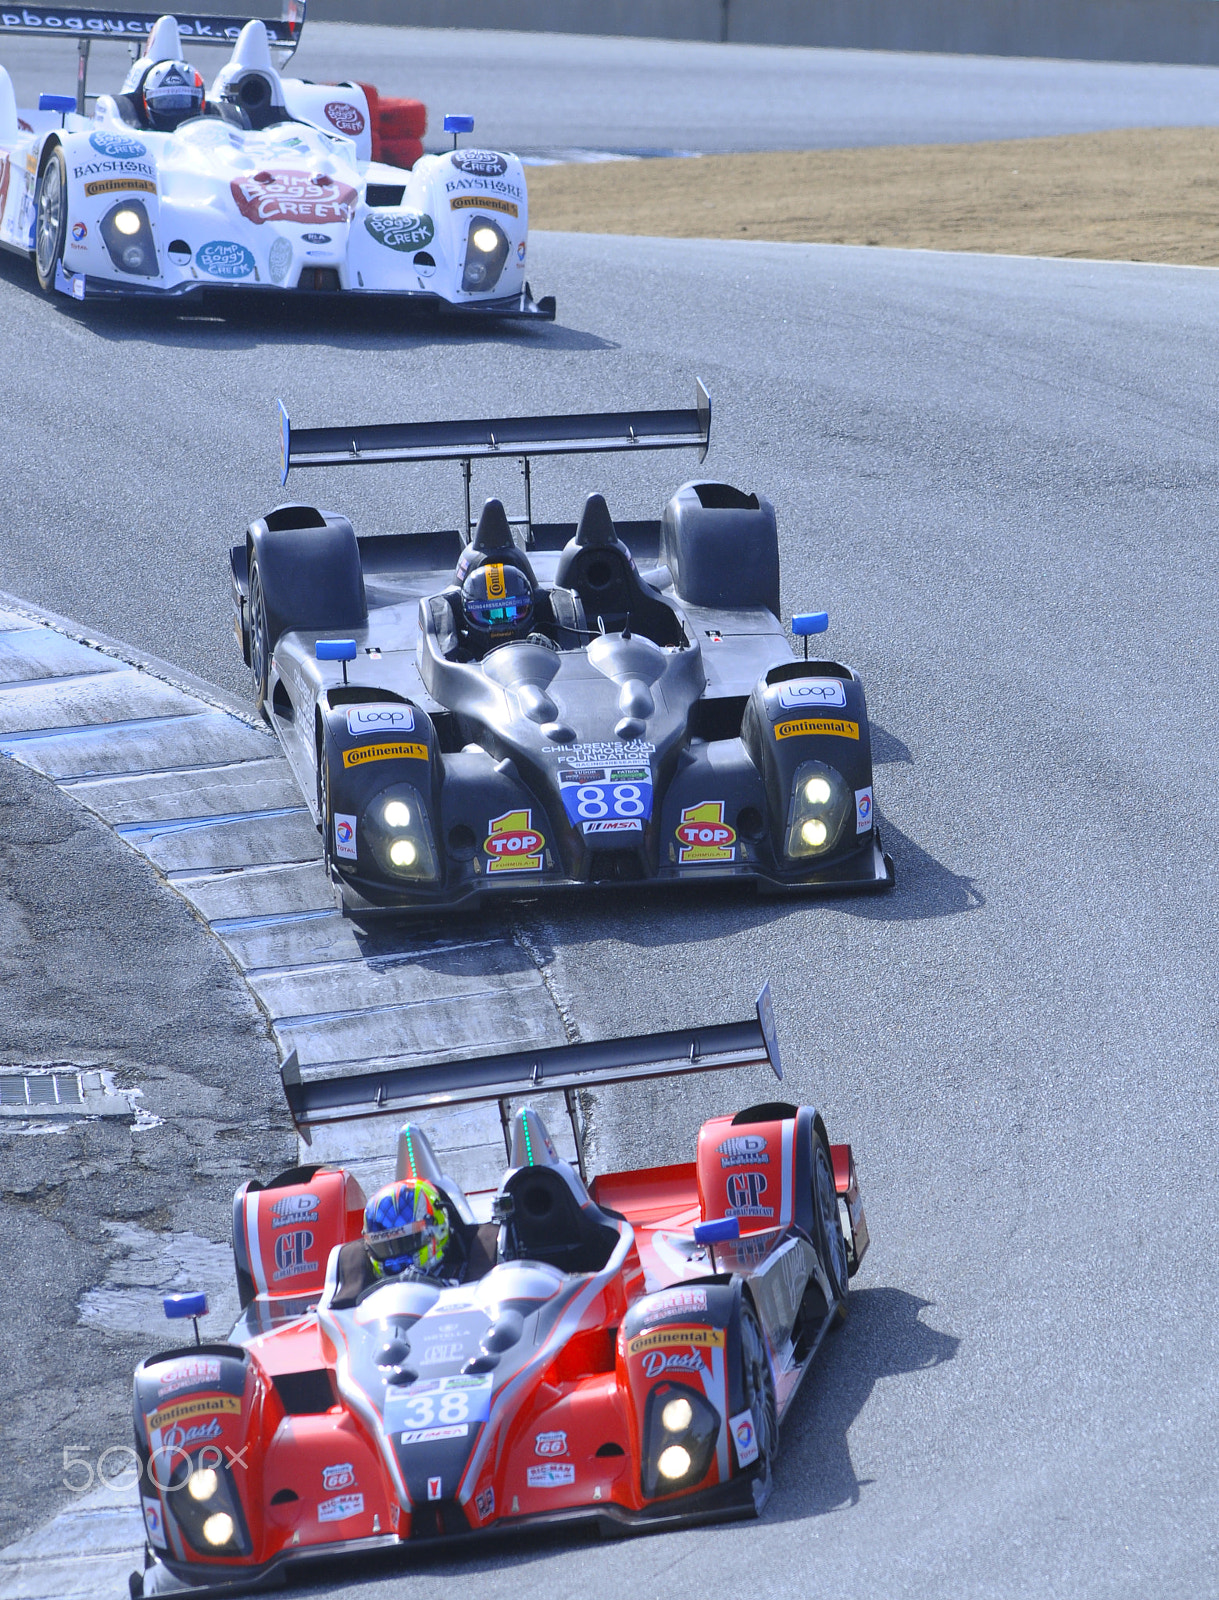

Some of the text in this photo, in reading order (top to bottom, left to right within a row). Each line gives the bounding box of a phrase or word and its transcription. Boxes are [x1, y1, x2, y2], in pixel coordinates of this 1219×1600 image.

[105, 144, 145, 155] CREEK
[461, 162, 502, 173] CREEK
[86, 181, 148, 195] Continental
[445, 179, 523, 198] BAYSHORE
[258, 199, 348, 219] CREEK
[452, 197, 509, 211] Continental
[383, 226, 432, 245] CREEK
[204, 245, 239, 255] CAMP
[208, 264, 250, 275] CREEK
[789, 686, 836, 699] Loop
[357, 711, 404, 725] Loop
[778, 721, 845, 736] Continental
[541, 741, 622, 753] CHILDREN'S
[574, 747, 624, 756] TUMOR
[347, 746, 414, 764] Continental
[557, 752, 649, 764] FOUNDATION
[577, 785, 645, 819] 88
[602, 821, 638, 830] IMSA
[683, 828, 728, 843] TOP
[336, 844, 355, 854] TOTAL
[492, 836, 538, 852] TOP
[687, 851, 727, 859] FORMULA-1
[495, 860, 535, 869] FORMULA-1
[726, 1172, 768, 1209] GP
[274, 1230, 314, 1271] GP
[630, 1332, 707, 1352] Continental
[642, 1345, 706, 1378] Dash
[150, 1399, 224, 1429] Continental
[403, 1392, 469, 1429] 38
[164, 1418, 223, 1456] Dash
[424, 1429, 463, 1439] IMSA
[540, 1441, 562, 1453] 66
[328, 1473, 349, 1487] 66
